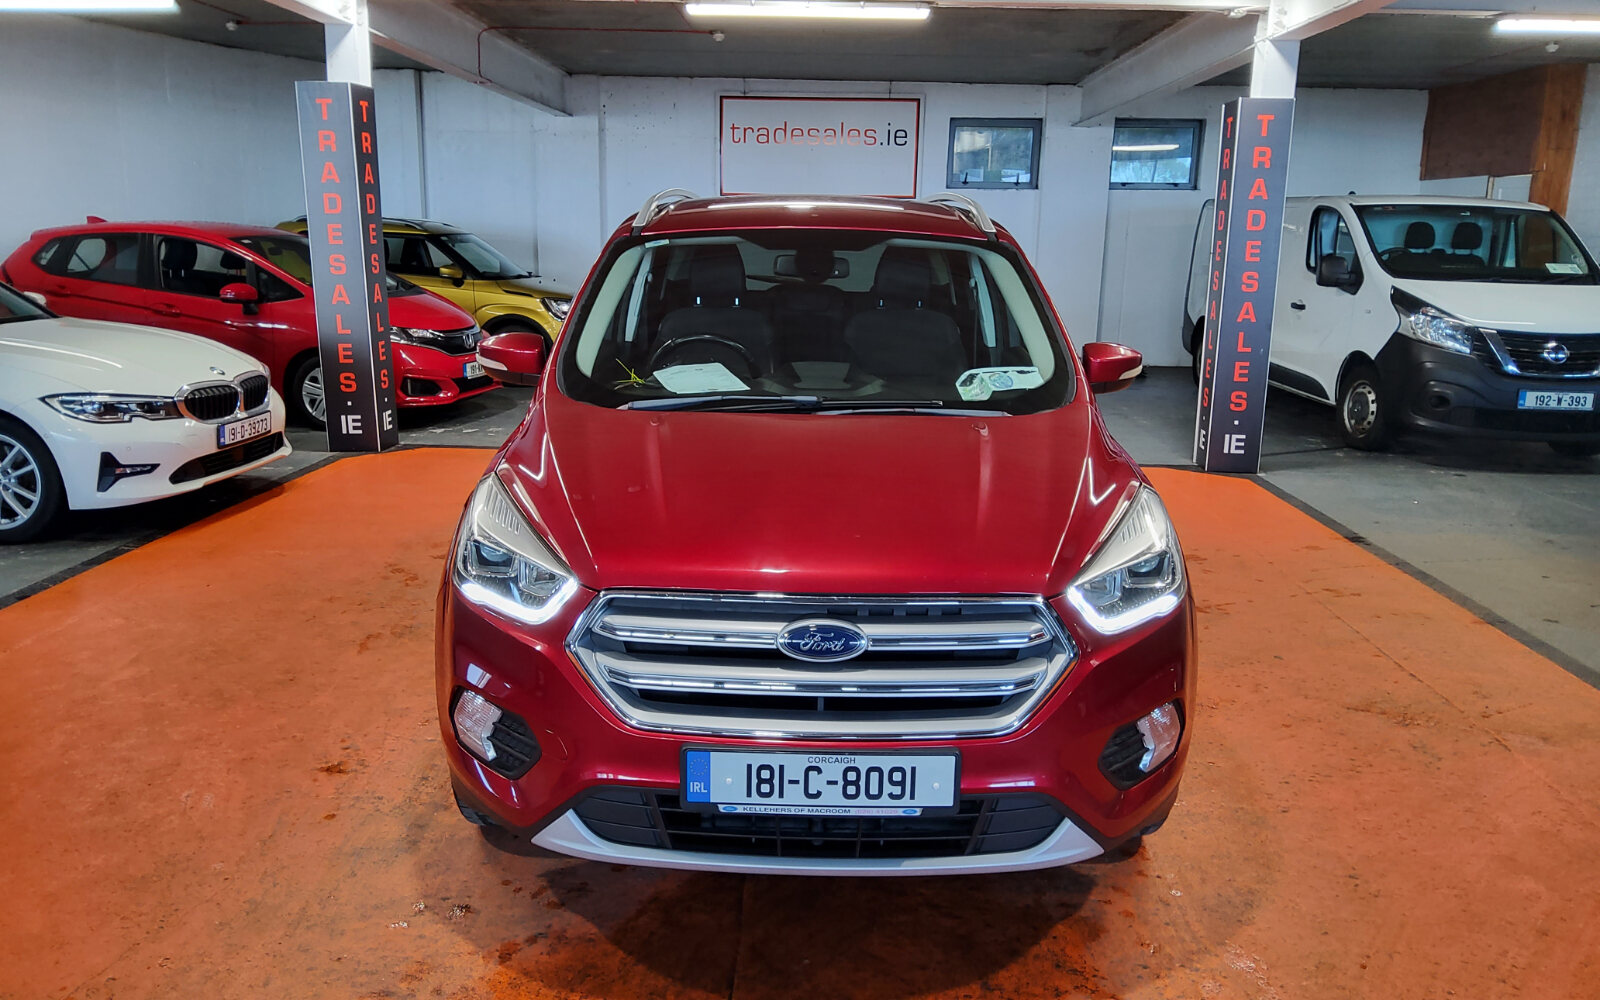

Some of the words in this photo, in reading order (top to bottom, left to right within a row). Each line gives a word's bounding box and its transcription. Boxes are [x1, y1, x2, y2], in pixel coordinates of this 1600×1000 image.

[730, 121, 908, 147] tradesales.ie
[1535, 394, 1588, 407] 192-W-393
[228, 417, 268, 442] 191-D-39273
[800, 632, 845, 651] Ford
[807, 756, 856, 765] CORCAIGH
[689, 781, 708, 794] IRL
[746, 763, 917, 801] 181-C-8091
[742, 806, 792, 814] KELLEHERS
